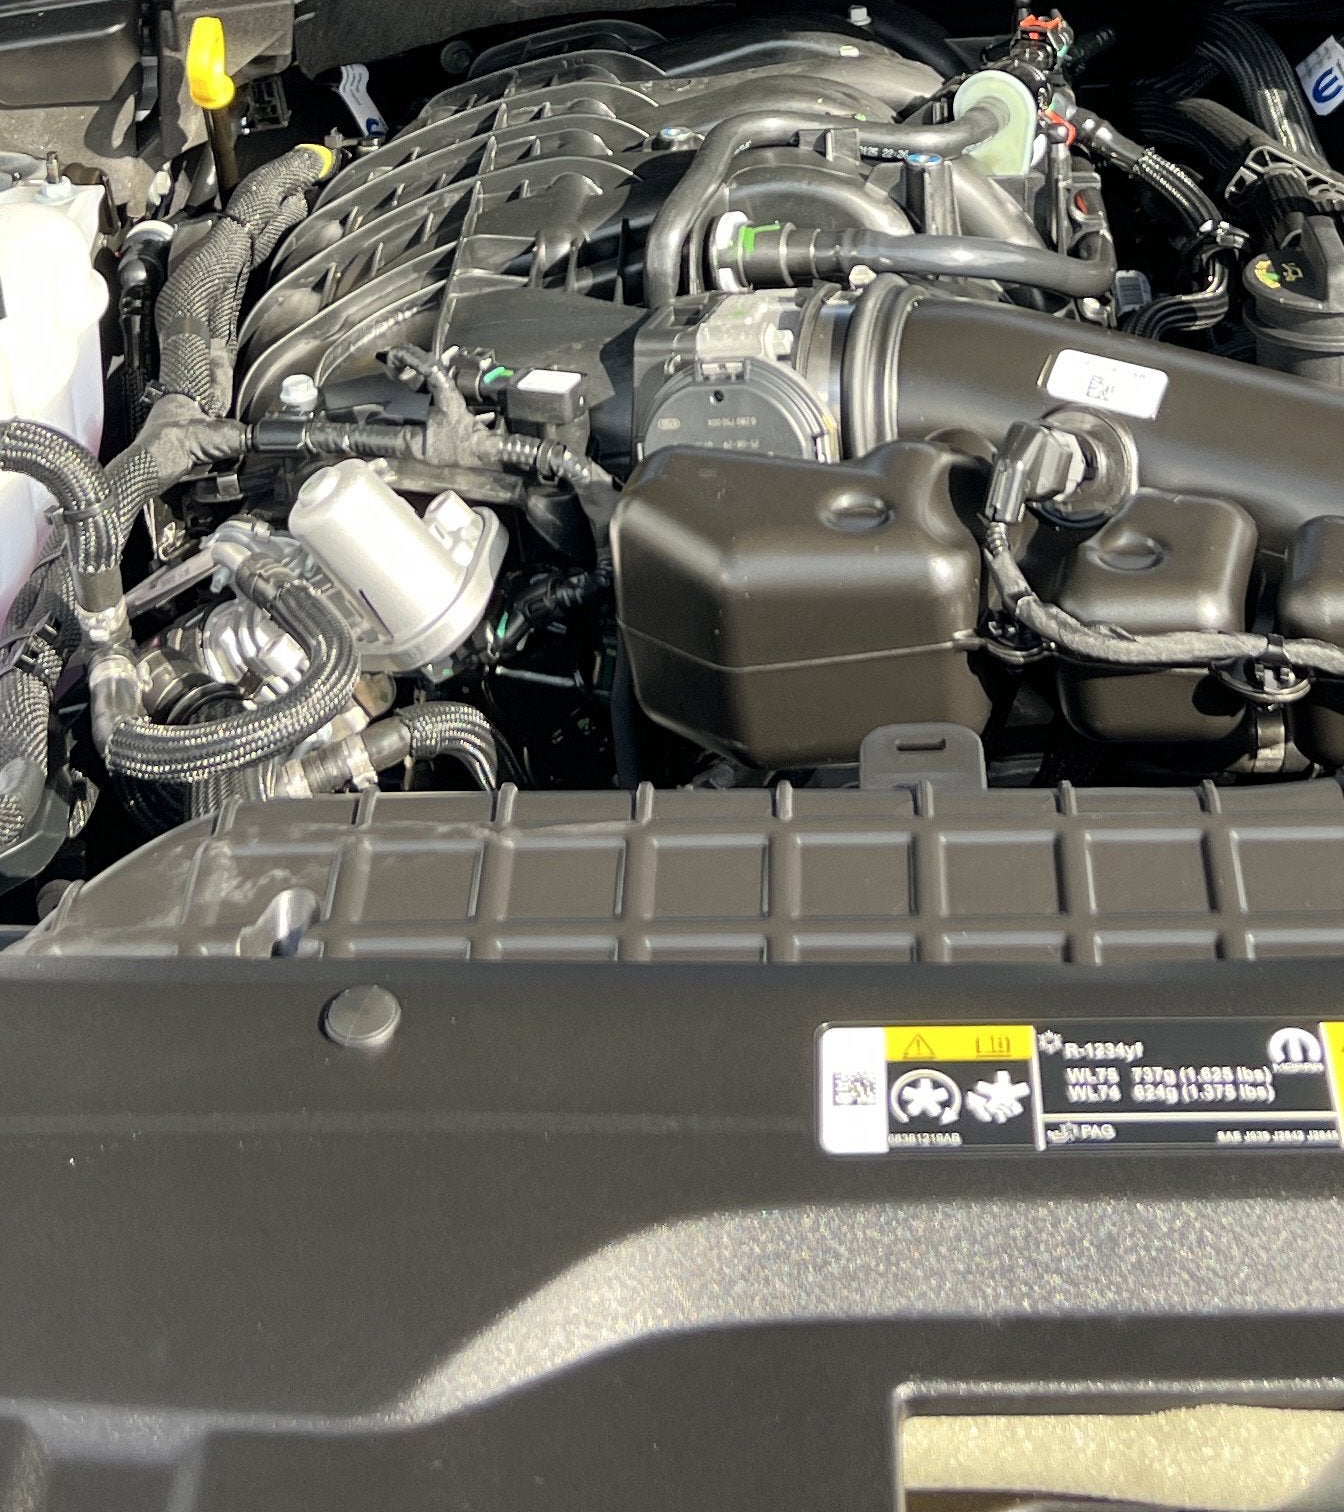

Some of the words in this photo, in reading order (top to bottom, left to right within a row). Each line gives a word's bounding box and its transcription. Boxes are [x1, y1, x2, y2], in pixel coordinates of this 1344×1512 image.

[1063, 1041, 1144, 1063] R-1234yf
[1066, 1067, 1120, 1084] WL75
[1131, 1067, 1176, 1085] 737g
[1180, 1066, 1235, 1084] (1.625
[1237, 1066, 1273, 1084] lbs)
[1068, 1084, 1122, 1102] WL74
[1132, 1084, 1179, 1105] 624g
[1181, 1084, 1237, 1103] (1.375
[1239, 1083, 1276, 1103] lbs)
[1081, 1124, 1116, 1140] PAG
[1217, 1130, 1242, 1142] SAE
